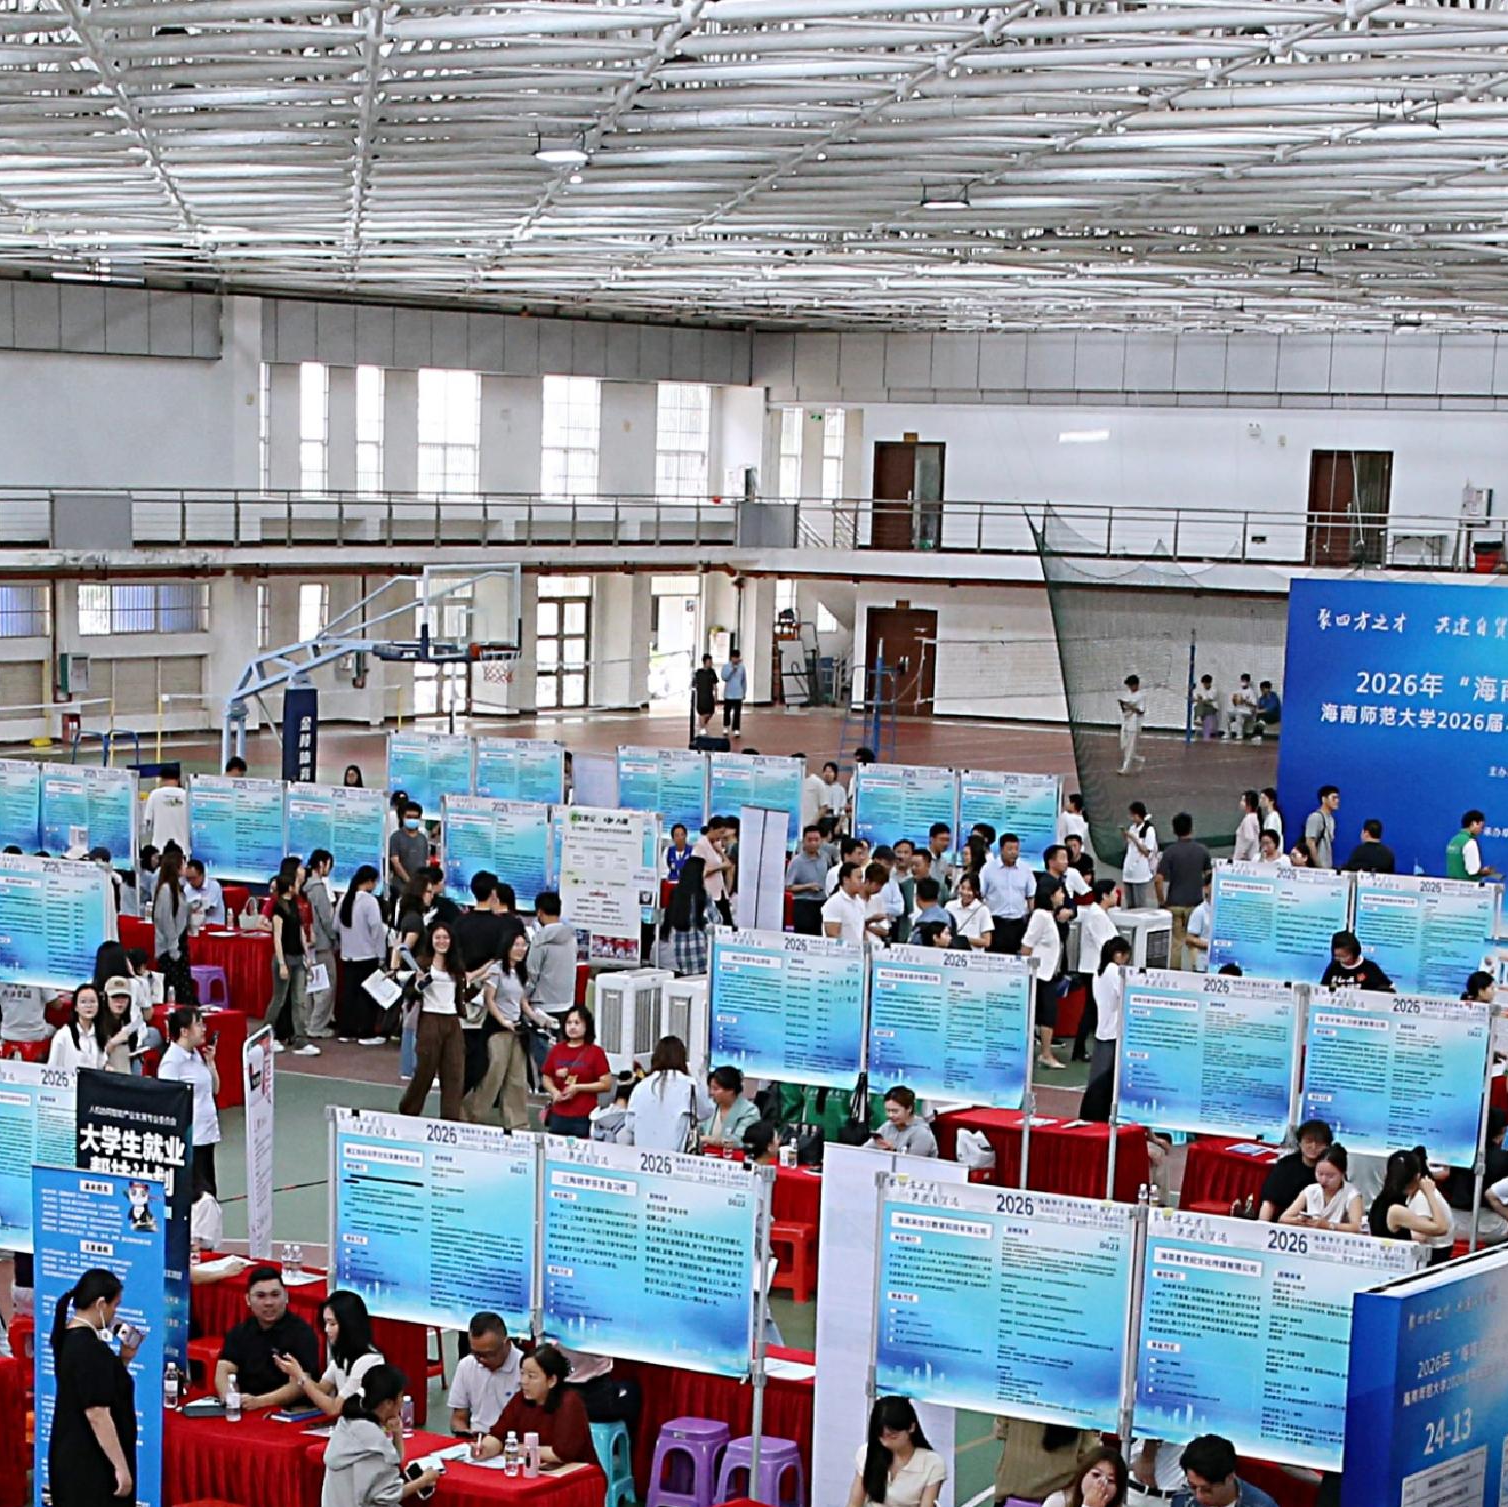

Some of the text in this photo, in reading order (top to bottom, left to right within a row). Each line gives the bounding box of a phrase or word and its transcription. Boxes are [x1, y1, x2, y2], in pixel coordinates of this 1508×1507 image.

[1317, 607, 1407, 634] 聚四方之才
[1355, 671, 1444, 699] 2026年
[784, 937, 806, 951] 2026
[944, 953, 967, 967] 2026
[1204, 978, 1229, 993] 2026
[1393, 998, 1421, 1014] 2026
[42, 1069, 69, 1087] 2026
[426, 1124, 457, 1144] 2026
[79, 1123, 186, 1167] 大学生就业
[641, 1153, 672, 1174] 2026
[996, 1193, 1034, 1216] 2026
[1268, 1229, 1308, 1254] 2026
[1424, 1407, 1472, 1456] 24-13
